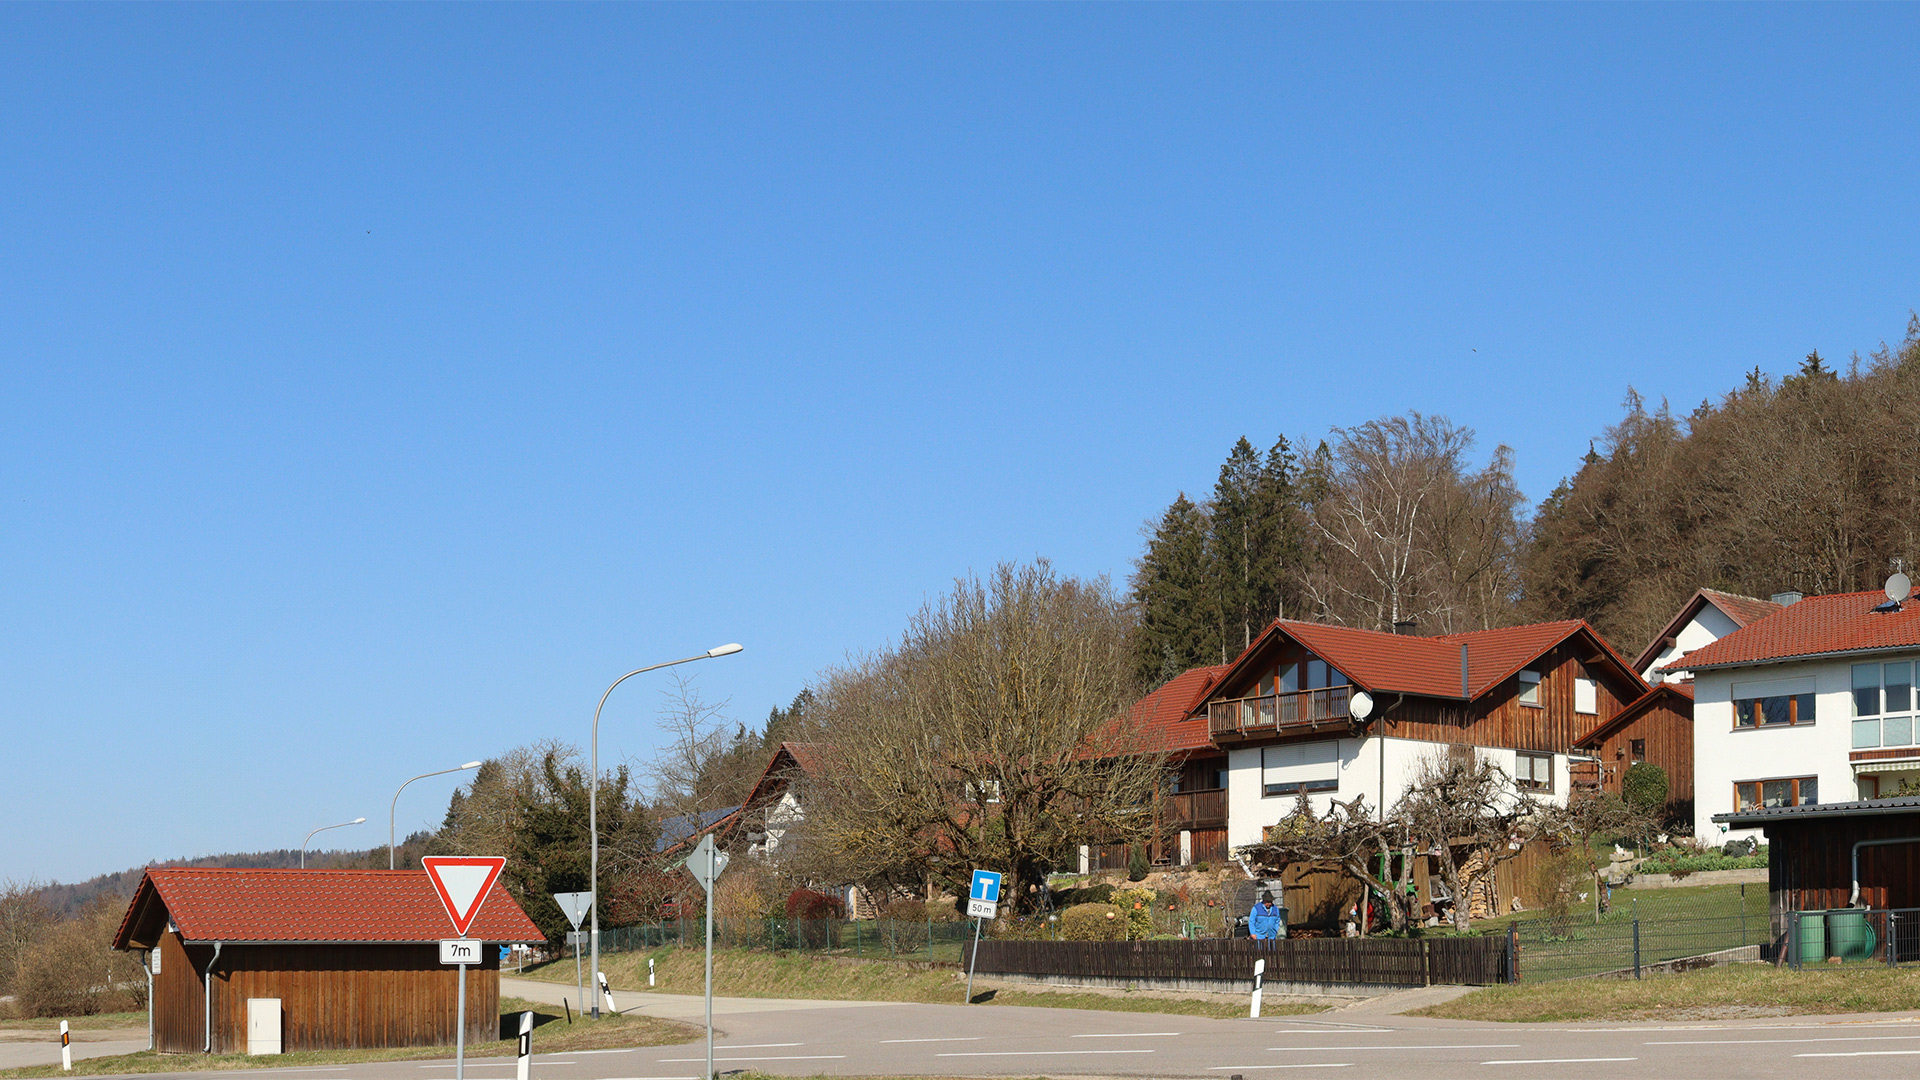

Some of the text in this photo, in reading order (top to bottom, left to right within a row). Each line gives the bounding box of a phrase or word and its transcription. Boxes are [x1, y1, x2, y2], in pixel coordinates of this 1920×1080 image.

[972, 903, 992, 914] 50 m
[451, 944, 471, 957] 7m
